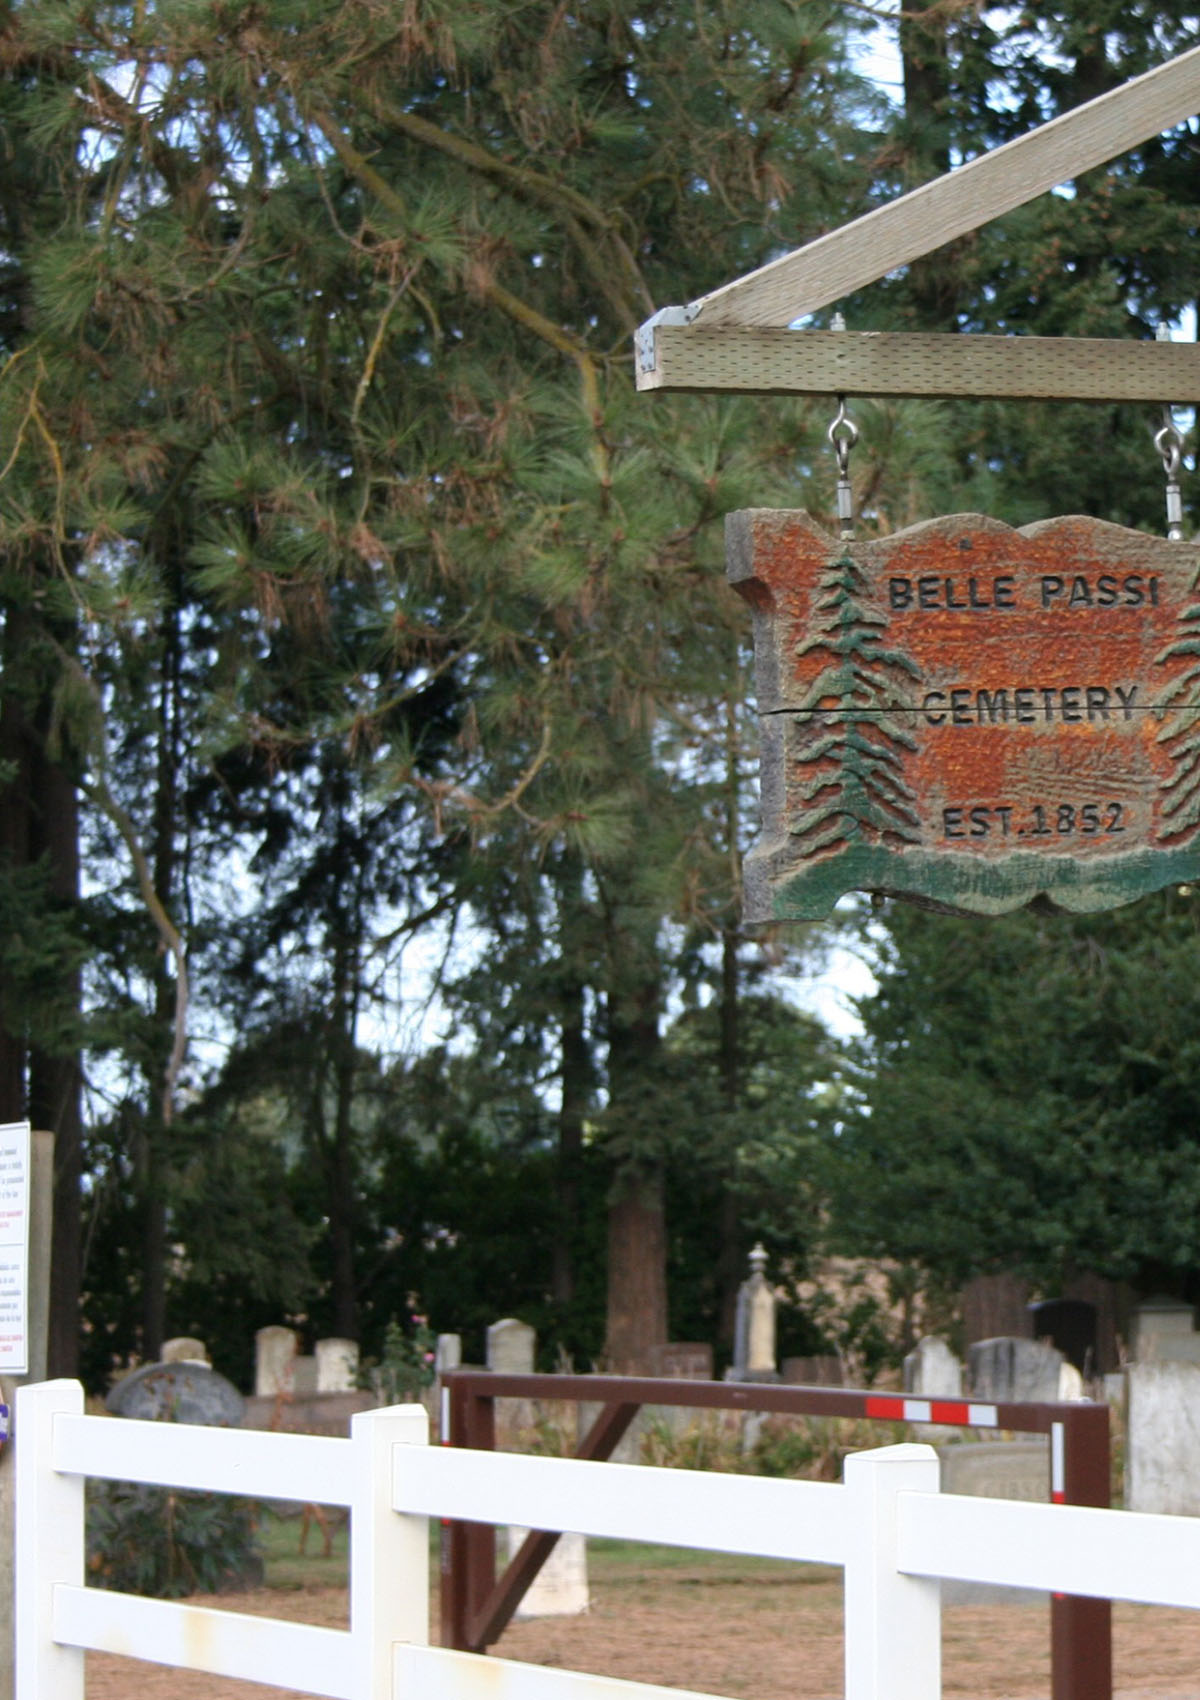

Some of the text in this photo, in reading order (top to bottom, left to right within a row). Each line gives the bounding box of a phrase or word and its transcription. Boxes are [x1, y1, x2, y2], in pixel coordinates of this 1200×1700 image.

[889, 575, 1160, 609] BELLE PASSI
[923, 686, 1138, 725] CEMETERY
